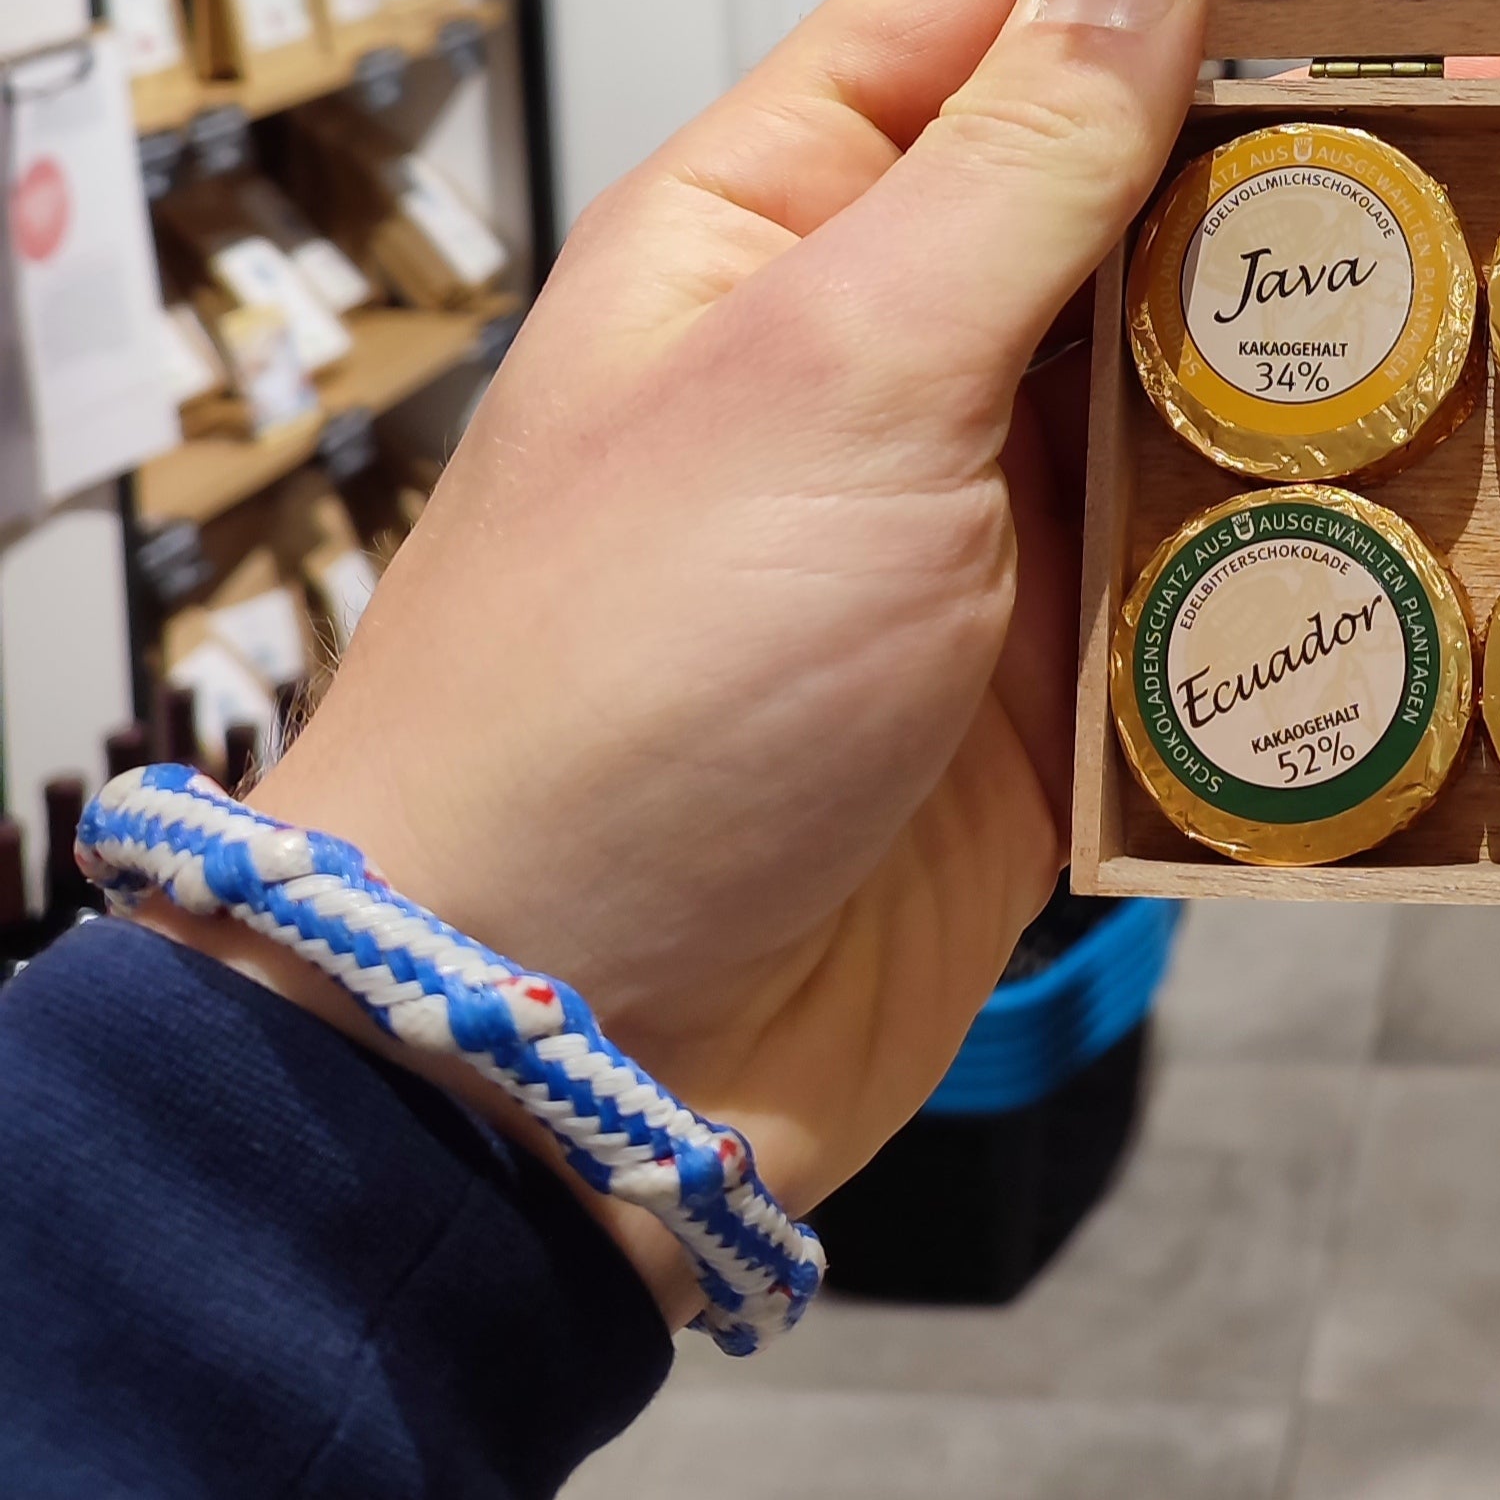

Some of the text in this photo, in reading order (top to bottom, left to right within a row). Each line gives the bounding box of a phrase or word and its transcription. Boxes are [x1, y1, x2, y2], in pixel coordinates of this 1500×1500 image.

[1250, 149, 1289, 169] AUS
[1203, 172, 1396, 240] EDELVOLLMILCHSCHOKOLADE
[1213, 247, 1378, 324] Java
[1238, 341, 1349, 358] KAKAOGEHALT
[1255, 361, 1330, 393] 34%
[1179, 543, 1352, 631] EDELBITTERSCHOKOLADE
[1143, 513, 1432, 794] SCHOKOLADENSCHATZ AUS AUSGEWÄHLTEN PLANTAGEN
[1176, 593, 1385, 729] Ecuador
[1251, 702, 1361, 755] KAKAOGEHALT
[1277, 730, 1356, 785] 52%
